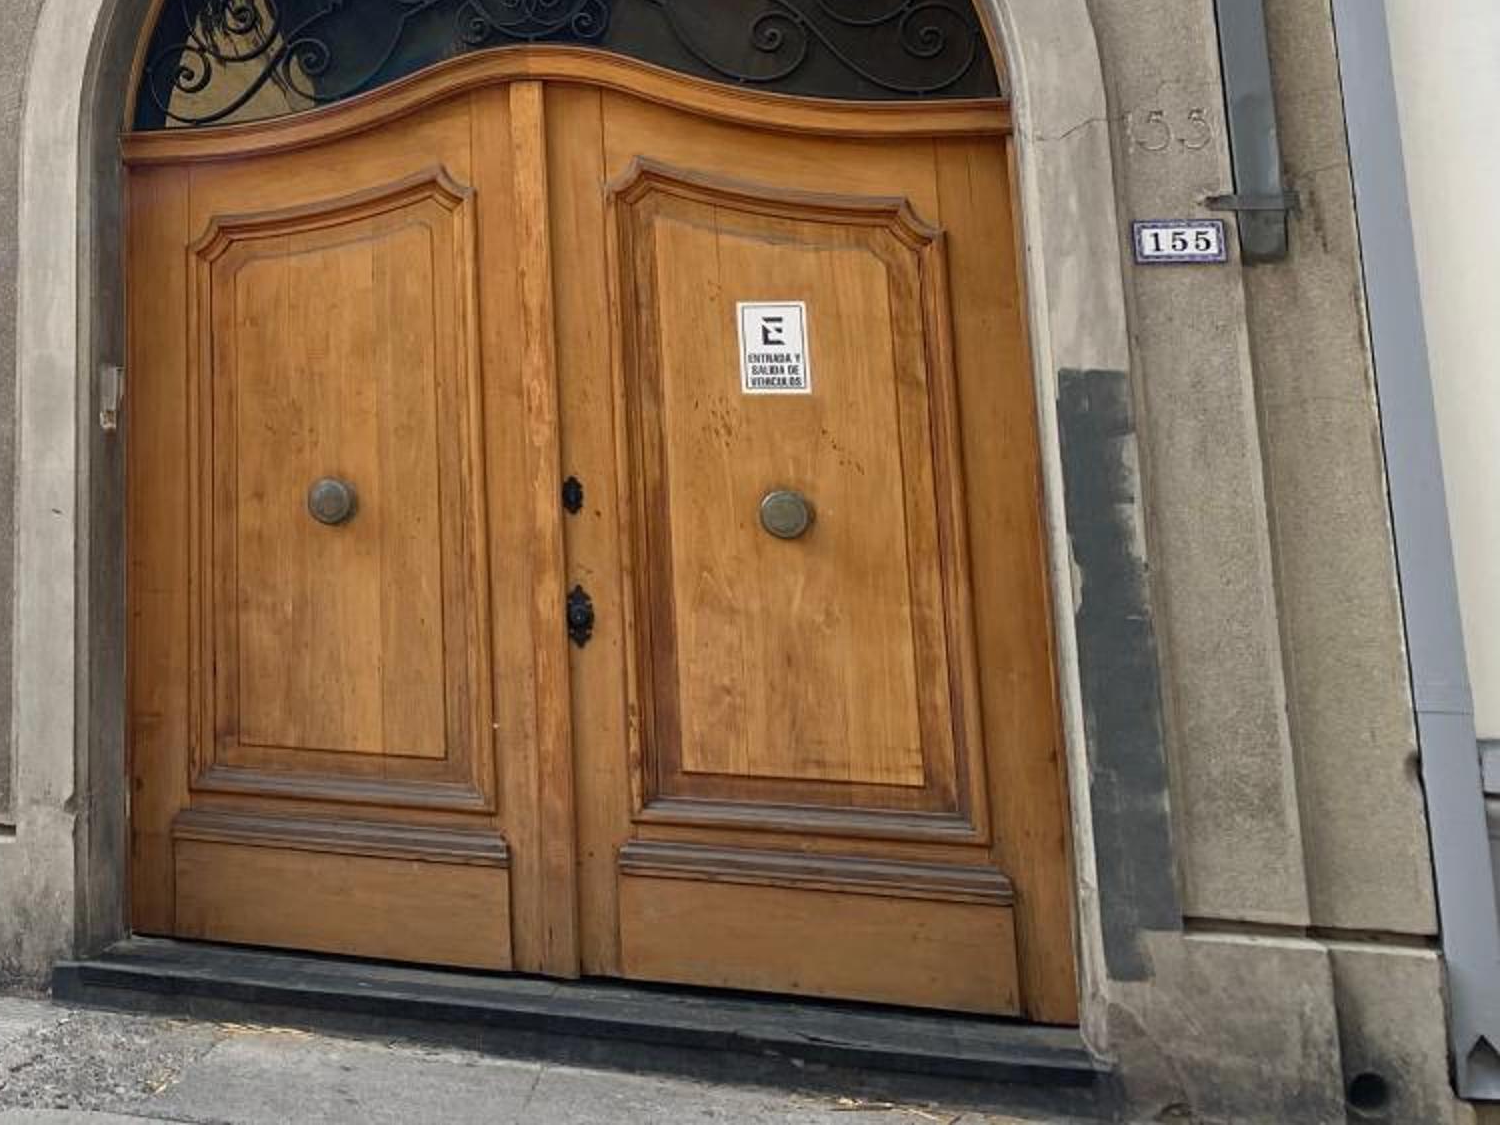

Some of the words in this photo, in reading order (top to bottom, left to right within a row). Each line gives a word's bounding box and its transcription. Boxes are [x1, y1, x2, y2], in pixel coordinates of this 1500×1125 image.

[1150, 231, 1211, 252] 155
[747, 353, 792, 363] ENTRADA
[796, 354, 801, 363] Y
[752, 364, 785, 375] SALIDA
[787, 364, 799, 375] DE
